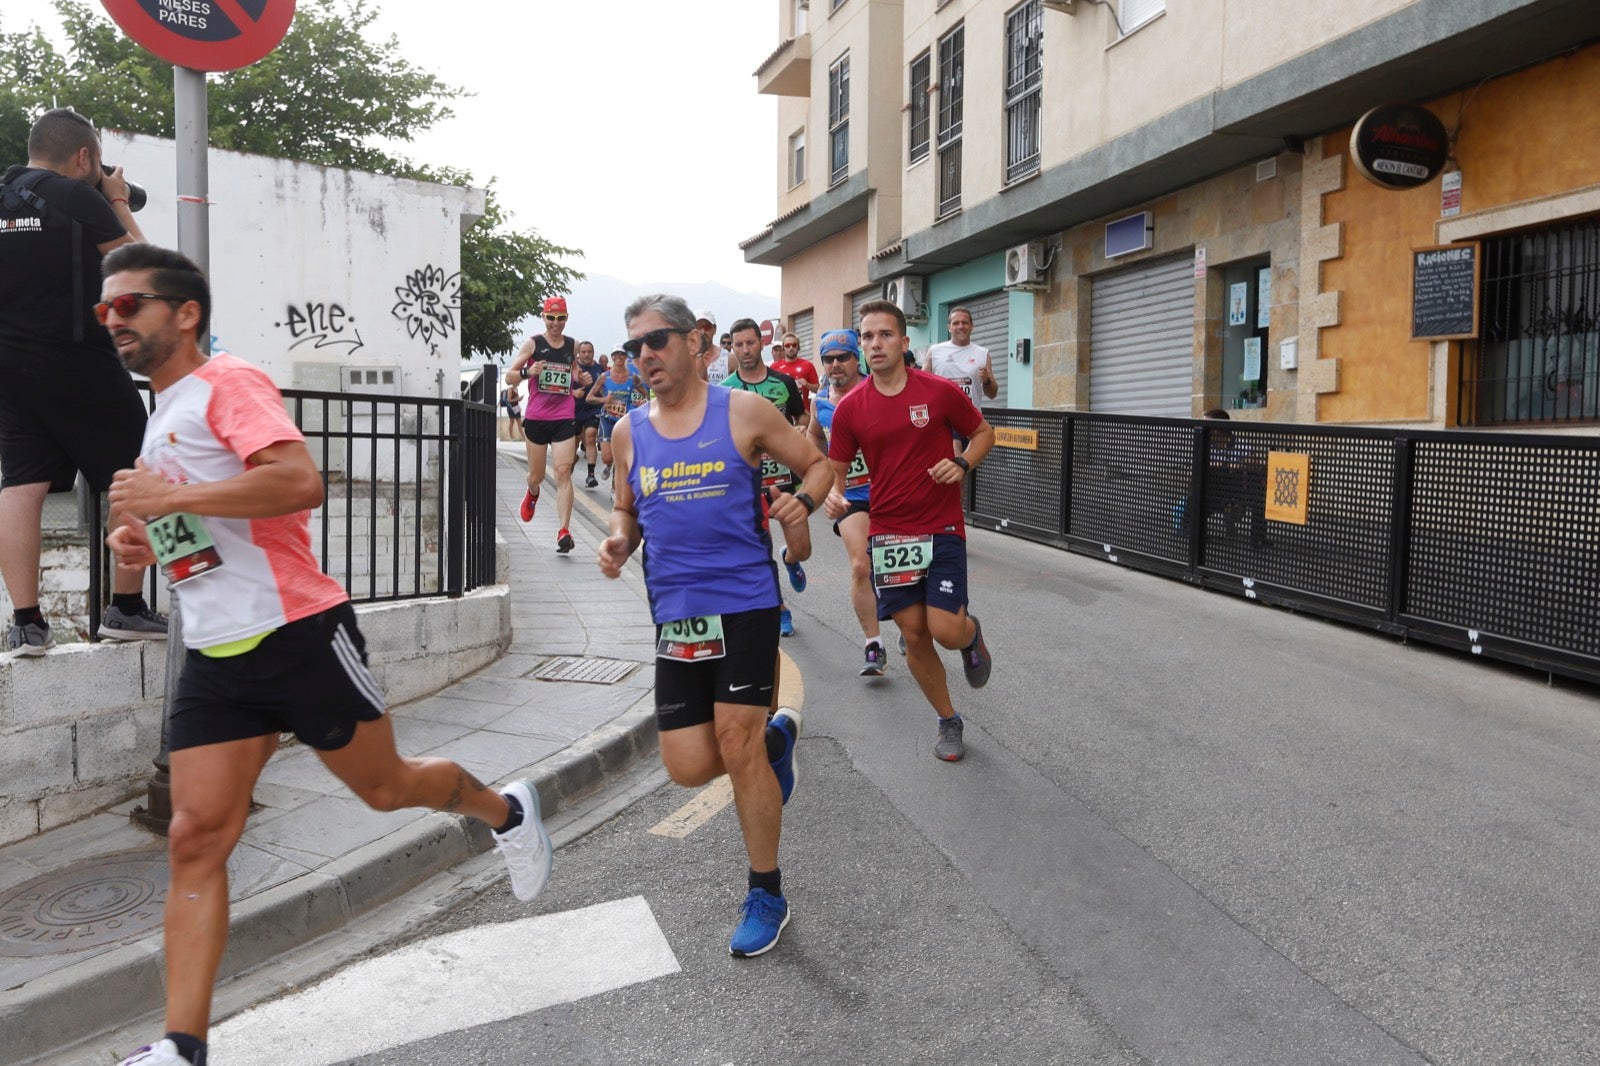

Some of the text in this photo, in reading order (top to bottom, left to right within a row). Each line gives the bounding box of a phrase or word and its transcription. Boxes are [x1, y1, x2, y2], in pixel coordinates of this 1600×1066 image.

[159, 0, 211, 15] MESES
[159, 9, 208, 29] PARES
[545, 371, 567, 384] 875
[661, 460, 726, 478] olimpo
[884, 545, 924, 569] 523
